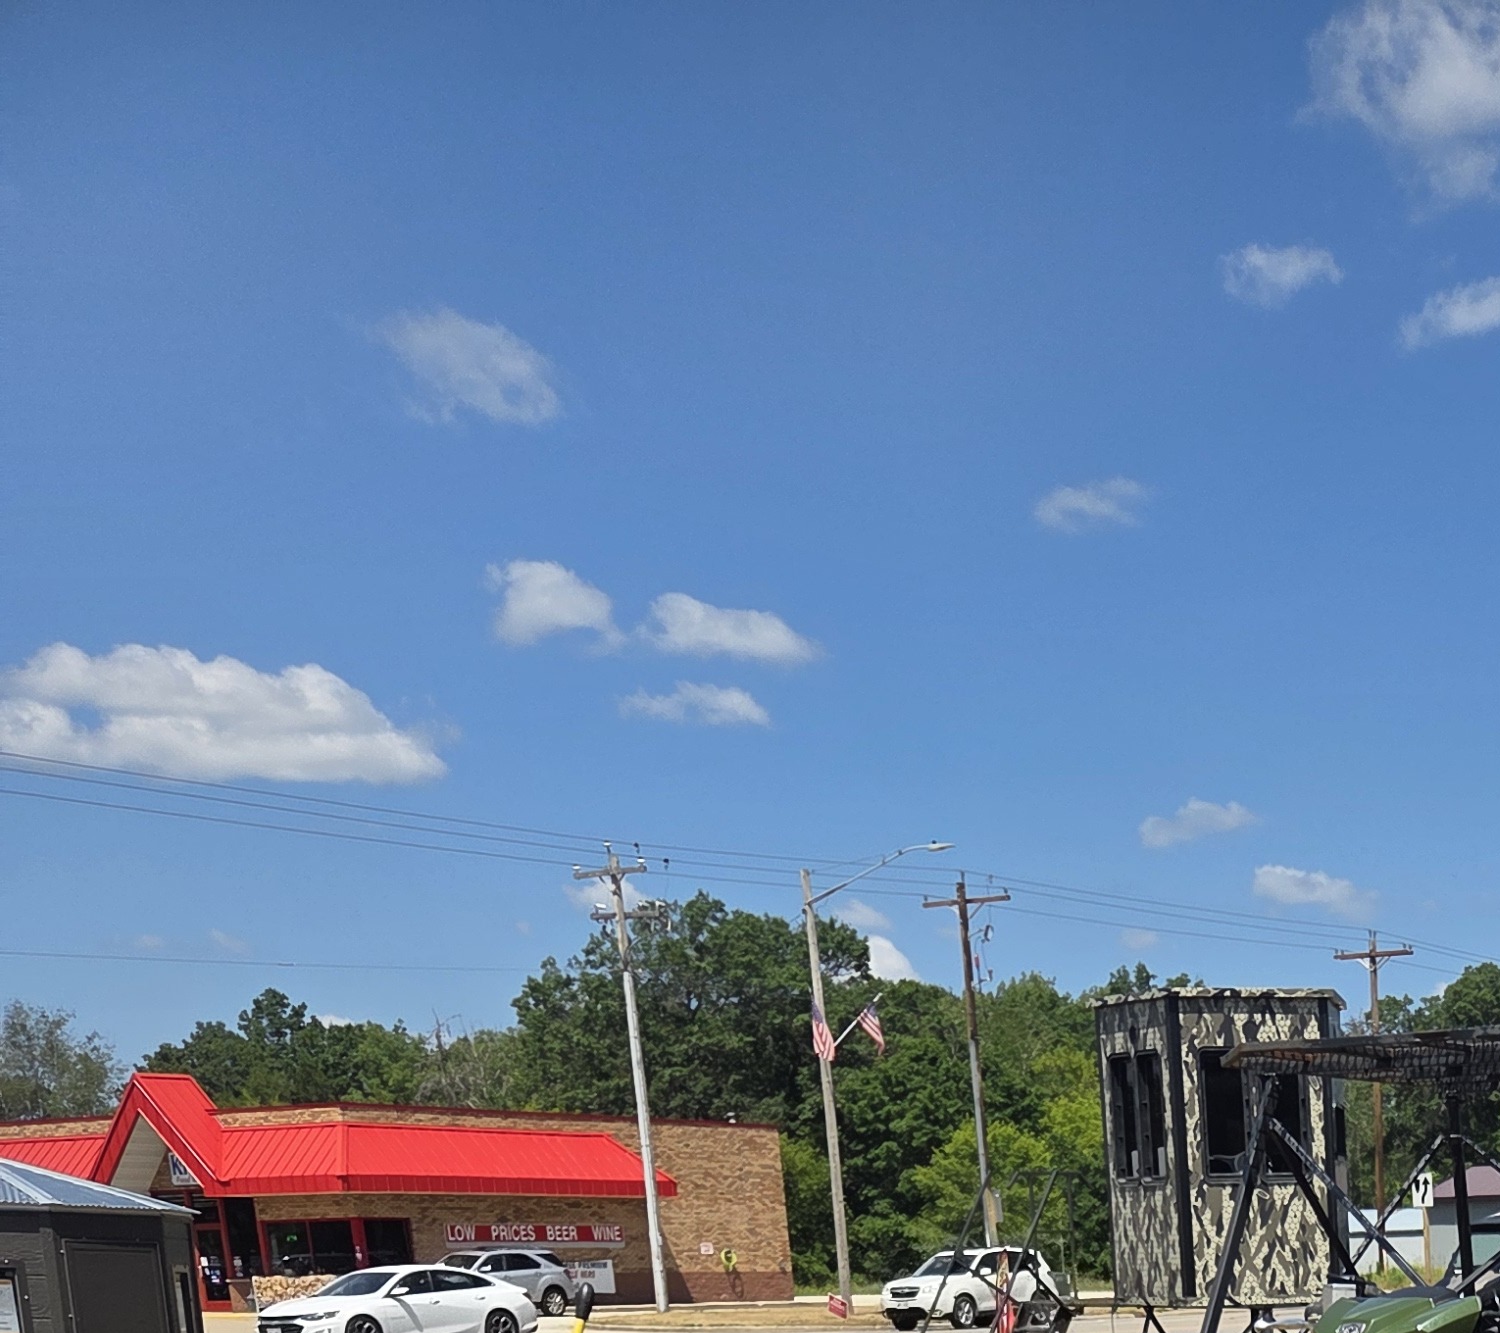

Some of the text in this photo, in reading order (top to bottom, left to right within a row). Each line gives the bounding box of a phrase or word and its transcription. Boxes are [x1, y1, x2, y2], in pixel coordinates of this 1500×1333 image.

[447, 1225, 622, 1241] LOW PRICES BEER WINE
